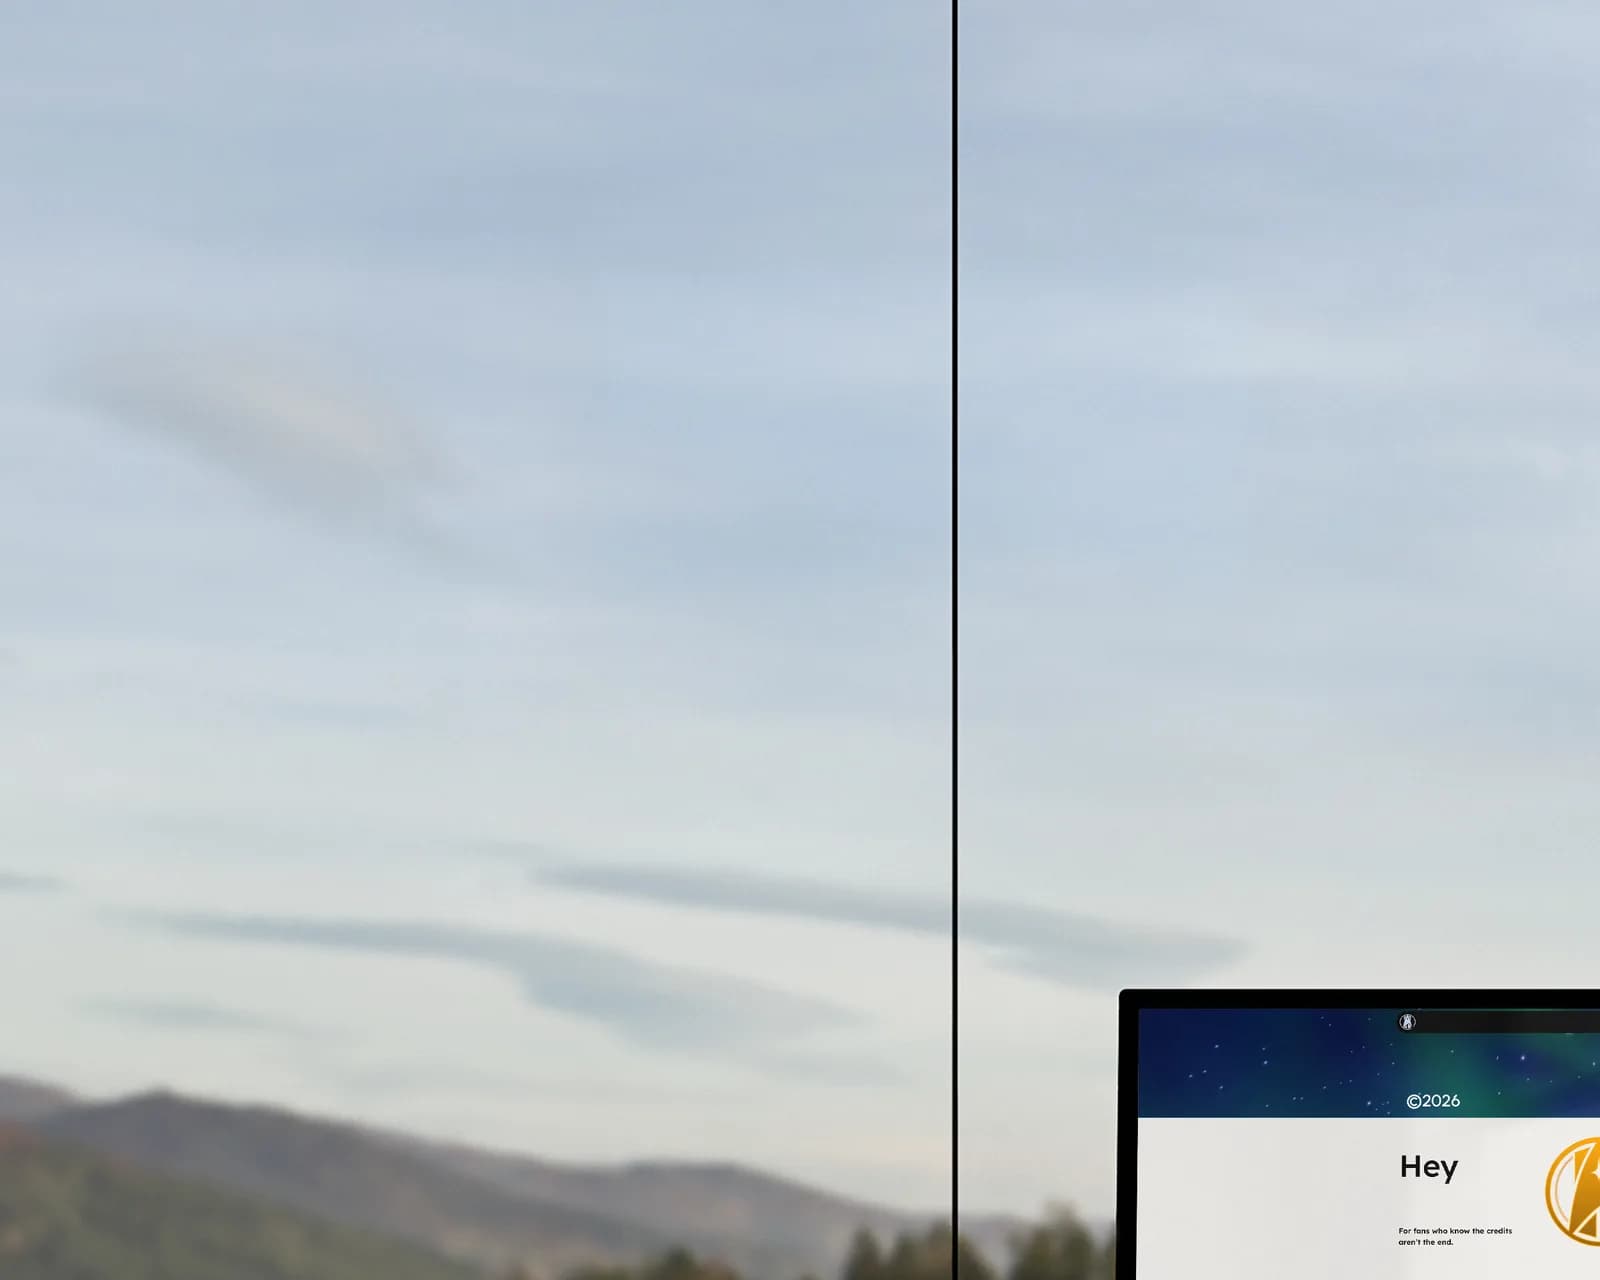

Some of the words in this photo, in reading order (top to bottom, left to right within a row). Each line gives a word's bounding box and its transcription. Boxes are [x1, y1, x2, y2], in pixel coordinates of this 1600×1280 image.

[1406, 1094, 1461, 1110] ©2026
[1401, 1154, 1459, 1184] Hey
[1423, 1238, 1436, 1246] the
[1437, 1238, 1454, 1246] end.
